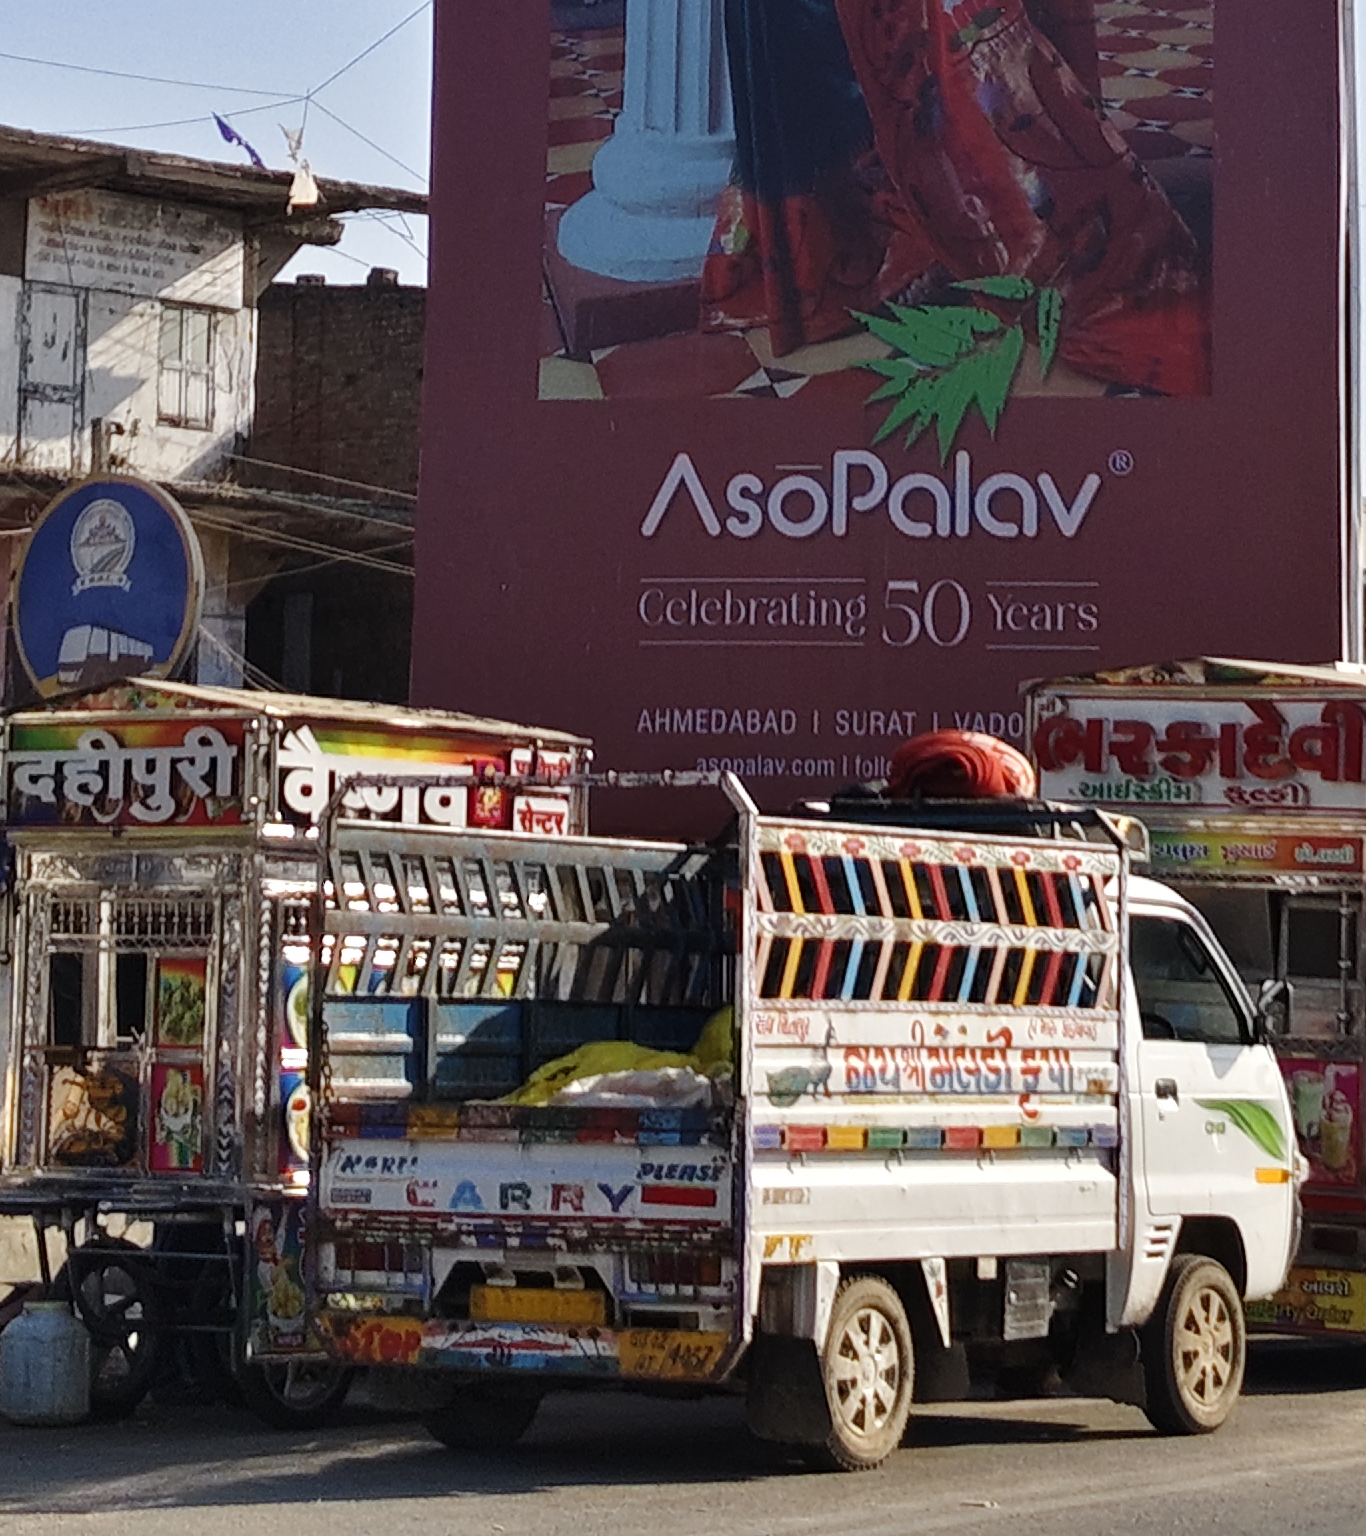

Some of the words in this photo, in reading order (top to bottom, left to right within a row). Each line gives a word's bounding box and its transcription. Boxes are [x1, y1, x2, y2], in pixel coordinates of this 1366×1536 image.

[638, 586, 867, 638] Celebrating
[882, 579, 971, 648] 50
[986, 591, 1100, 635] Years
[636, 708, 797, 736] AHMEDABAD
[835, 710, 917, 737] SURAT
[7, 725, 238, 823] दहीपुरी
[696, 754, 835, 780] asopalav.com
[406, 1178, 635, 1213] CARRY
